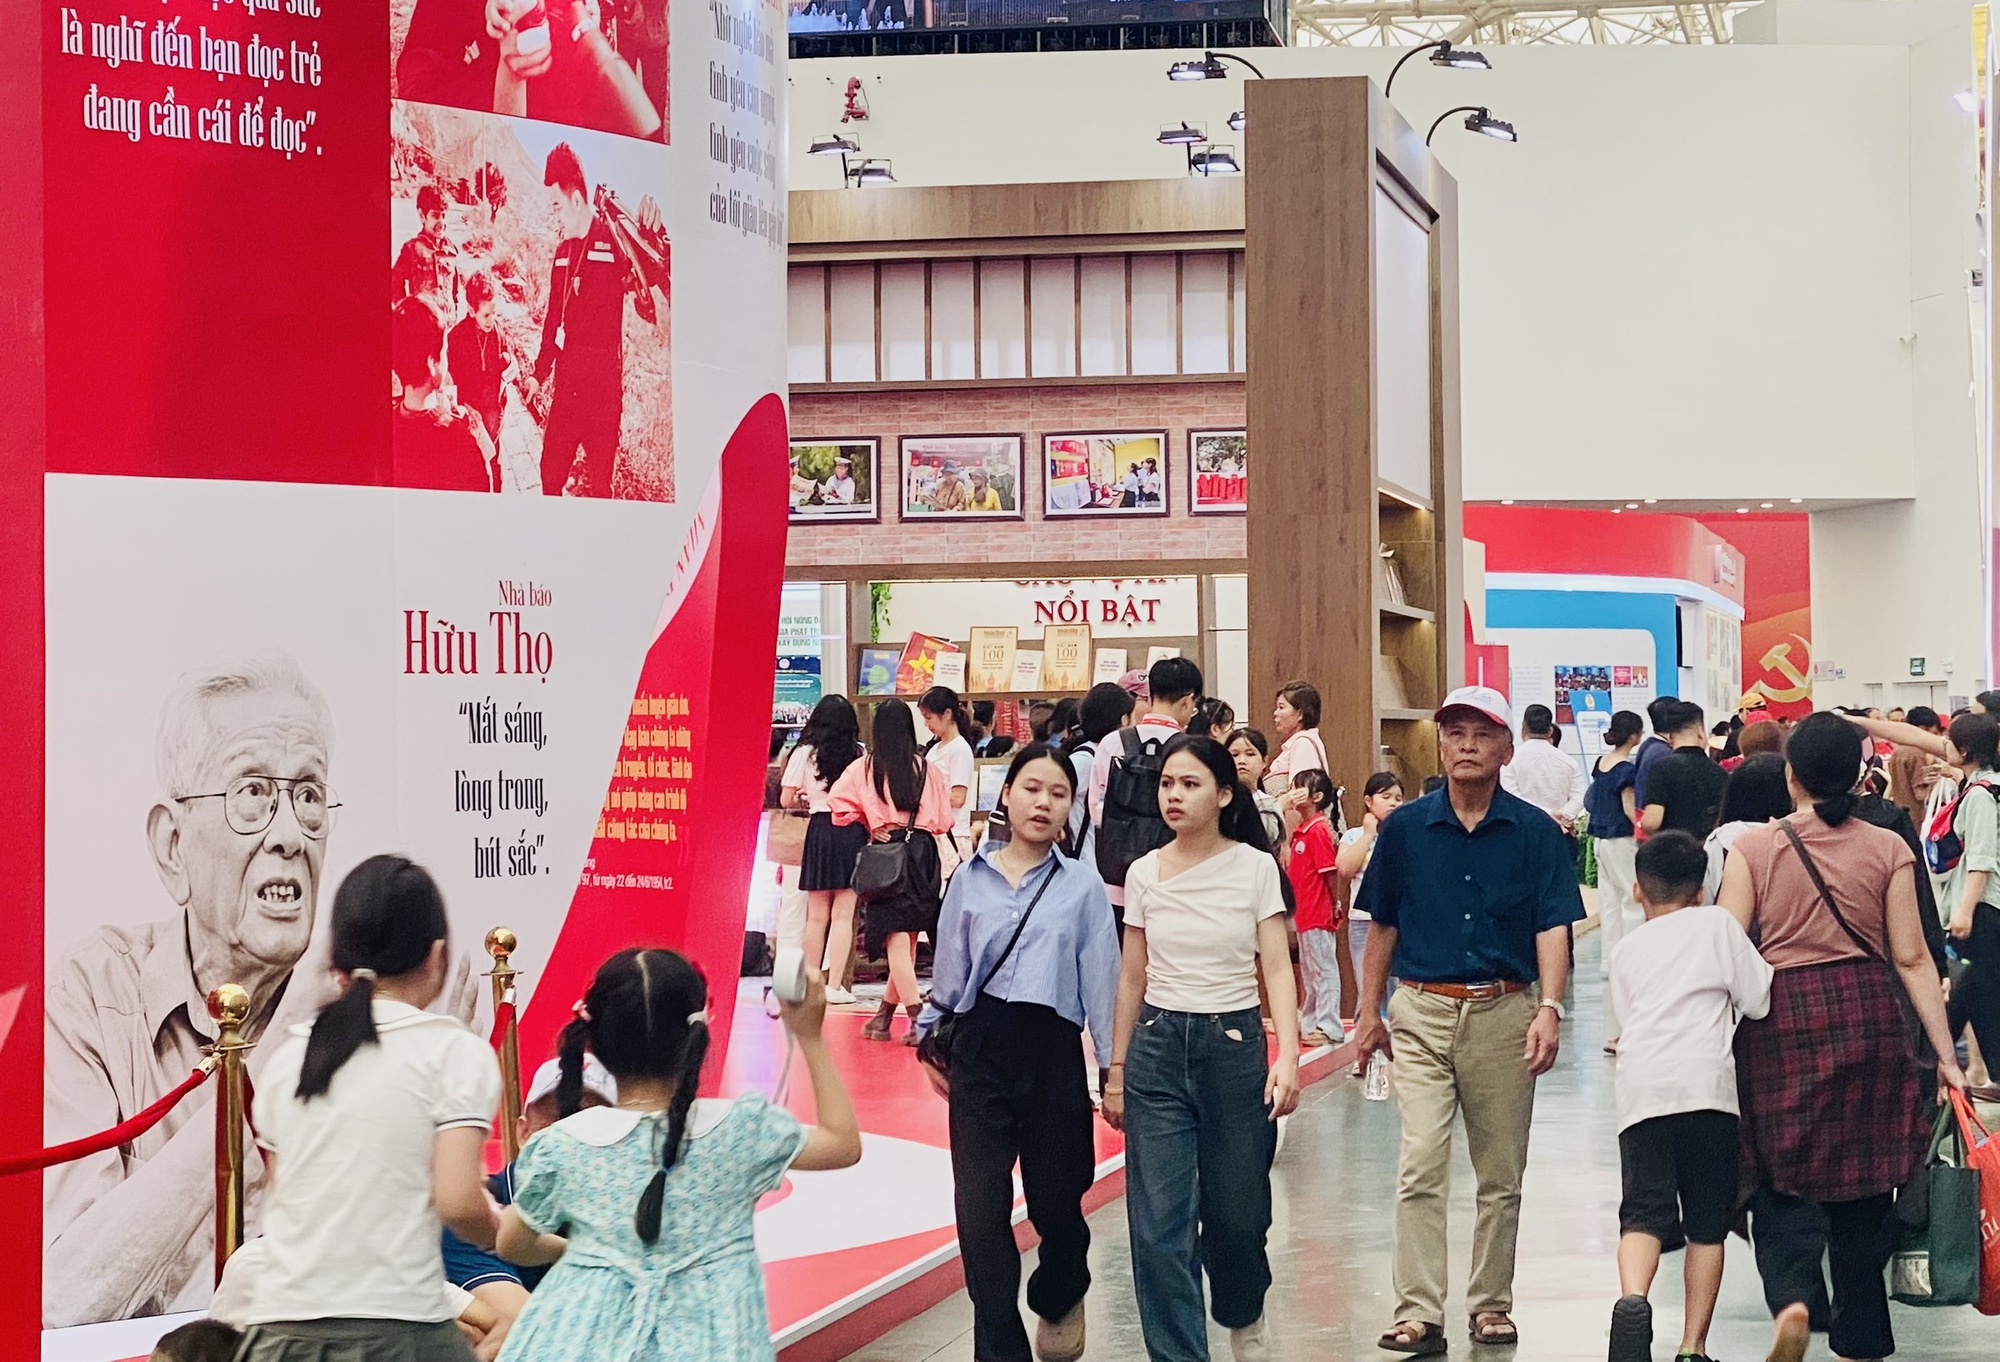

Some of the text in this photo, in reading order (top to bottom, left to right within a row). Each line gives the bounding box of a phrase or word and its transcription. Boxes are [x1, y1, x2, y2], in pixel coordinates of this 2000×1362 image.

[61, 8, 322, 87] là nghĩ đến bạn đọc trẻ
[83, 83, 141, 142] đang
[149, 86, 191, 140] cần
[198, 98, 231, 144] cái
[239, 95, 264, 147] để
[498, 580, 552, 607] Nhà báo
[1034, 590, 1161, 628] NỔI BẬT
[403, 609, 553, 684] Hữu Thọ
[459, 695, 547, 751] “Mắt sáng,
[455, 770, 492, 820] lòng
[498, 769, 549, 818] trong,
[474, 836, 503, 879] bút
